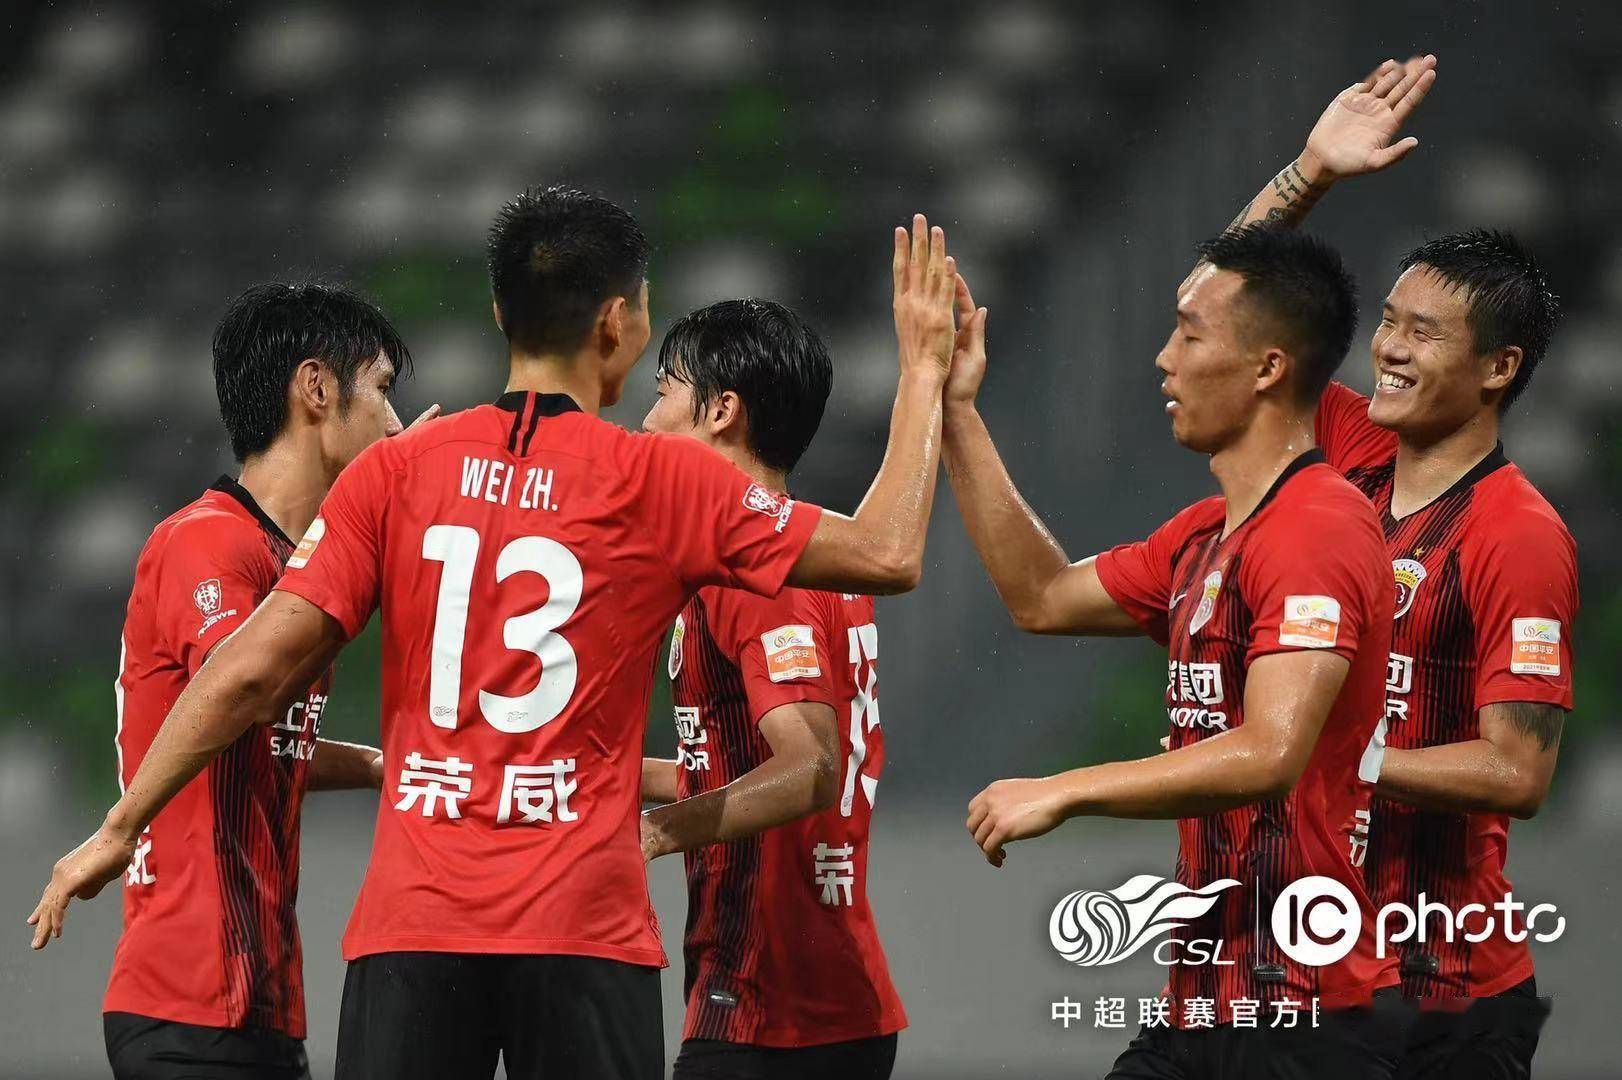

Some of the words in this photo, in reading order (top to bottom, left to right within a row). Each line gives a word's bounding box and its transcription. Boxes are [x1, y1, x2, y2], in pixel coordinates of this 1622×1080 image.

[460, 456, 515, 506] WEI
[422, 524, 584, 734] 13
[394, 752, 579, 824] 荣威
[813, 843, 854, 906] 荣
